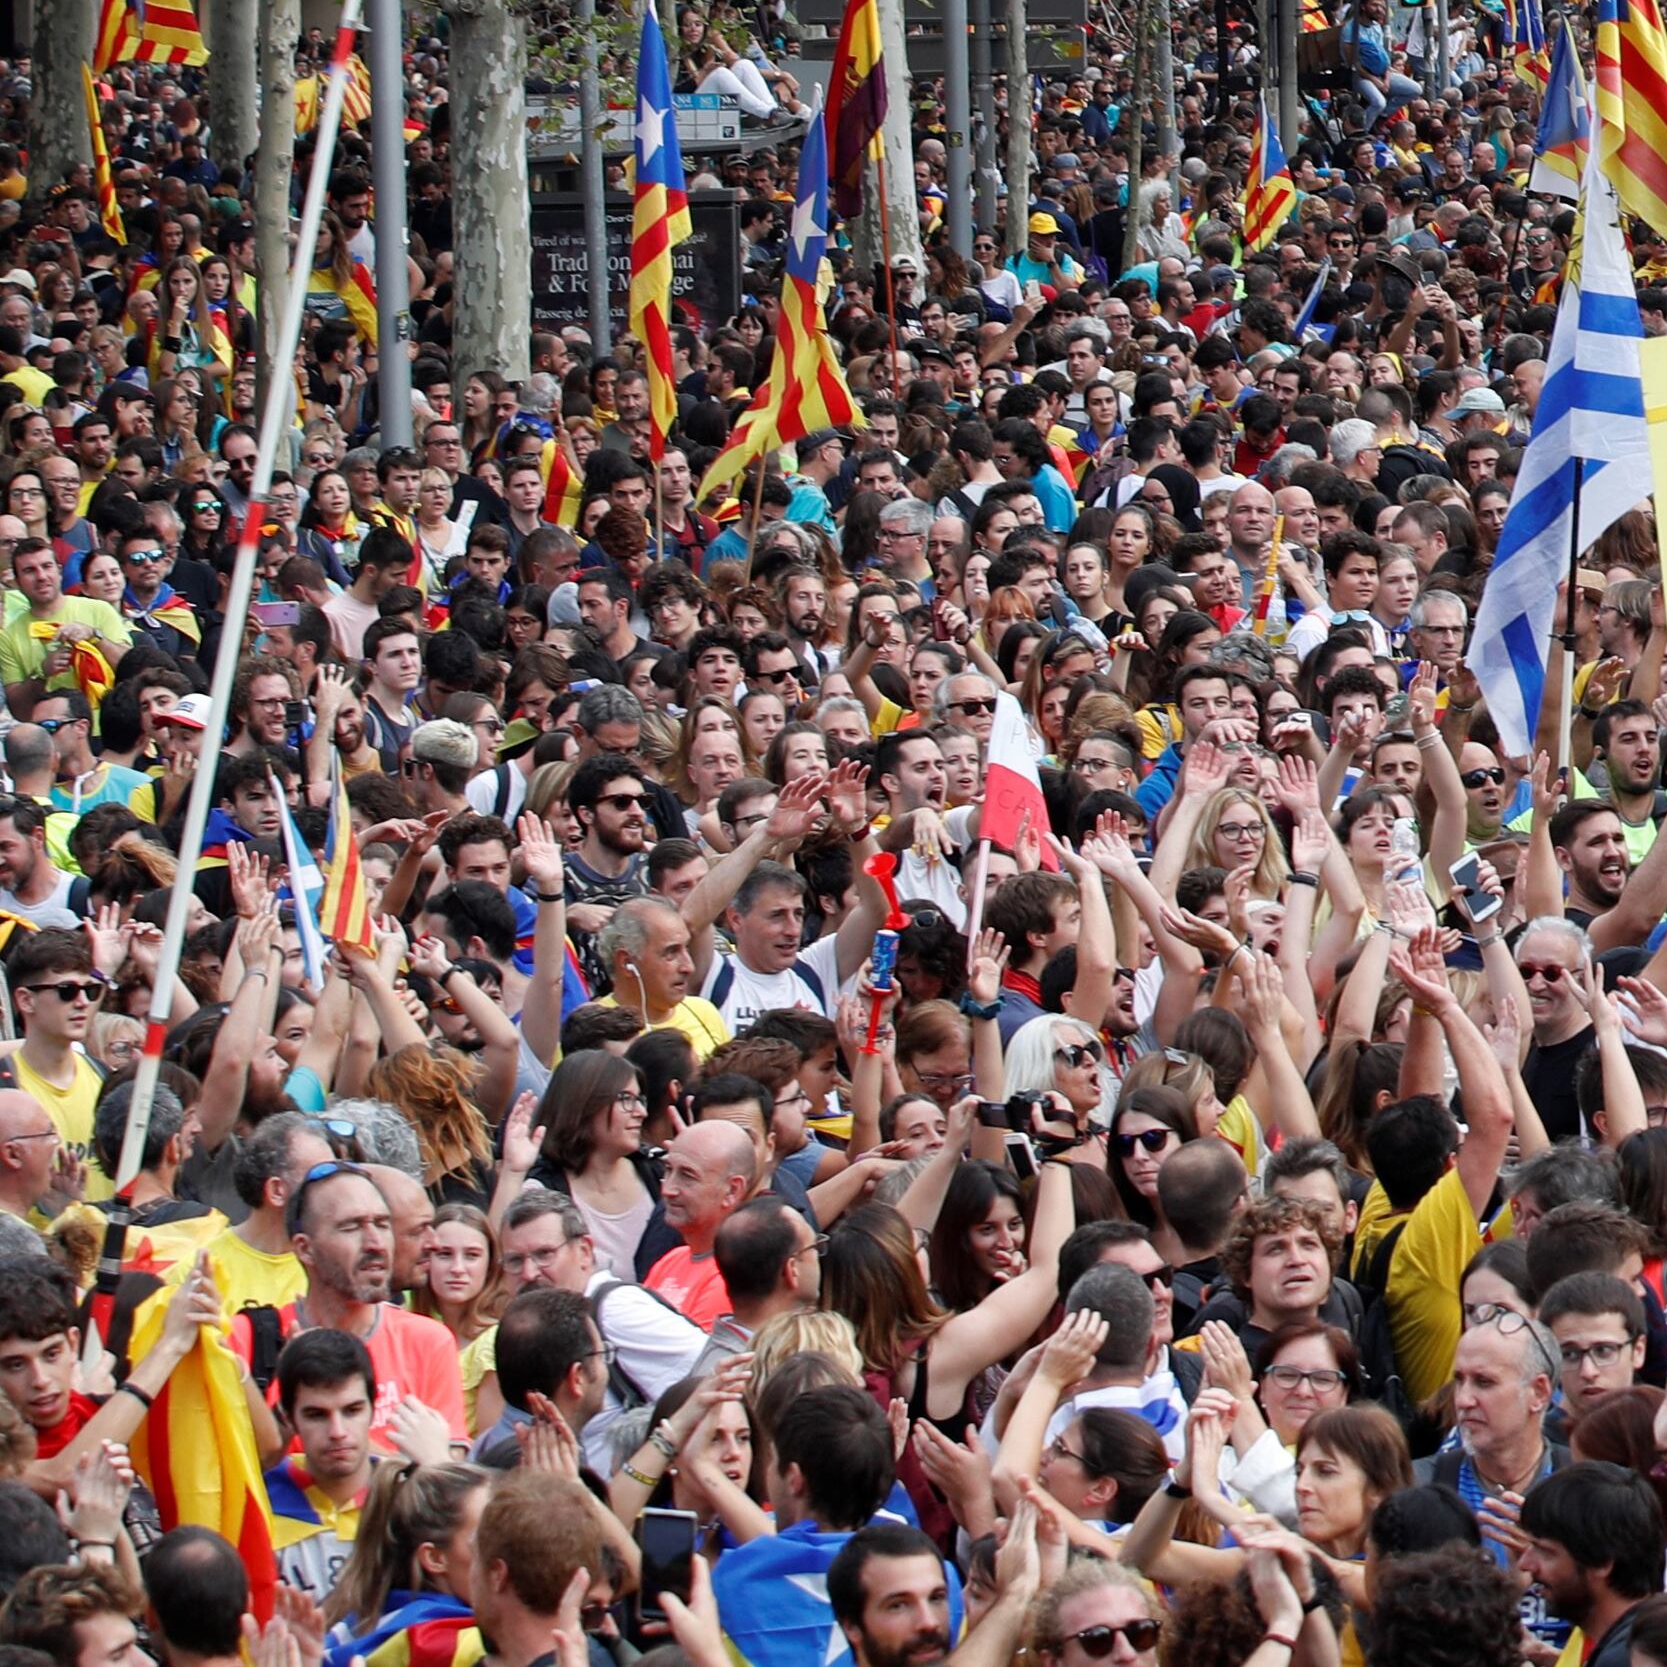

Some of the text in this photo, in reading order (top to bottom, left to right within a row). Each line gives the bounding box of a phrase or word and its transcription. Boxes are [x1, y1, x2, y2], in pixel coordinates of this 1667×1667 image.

[547, 251, 632, 272] Tradon
[548, 275, 563, 293] &
[570, 275, 613, 293] Fot
